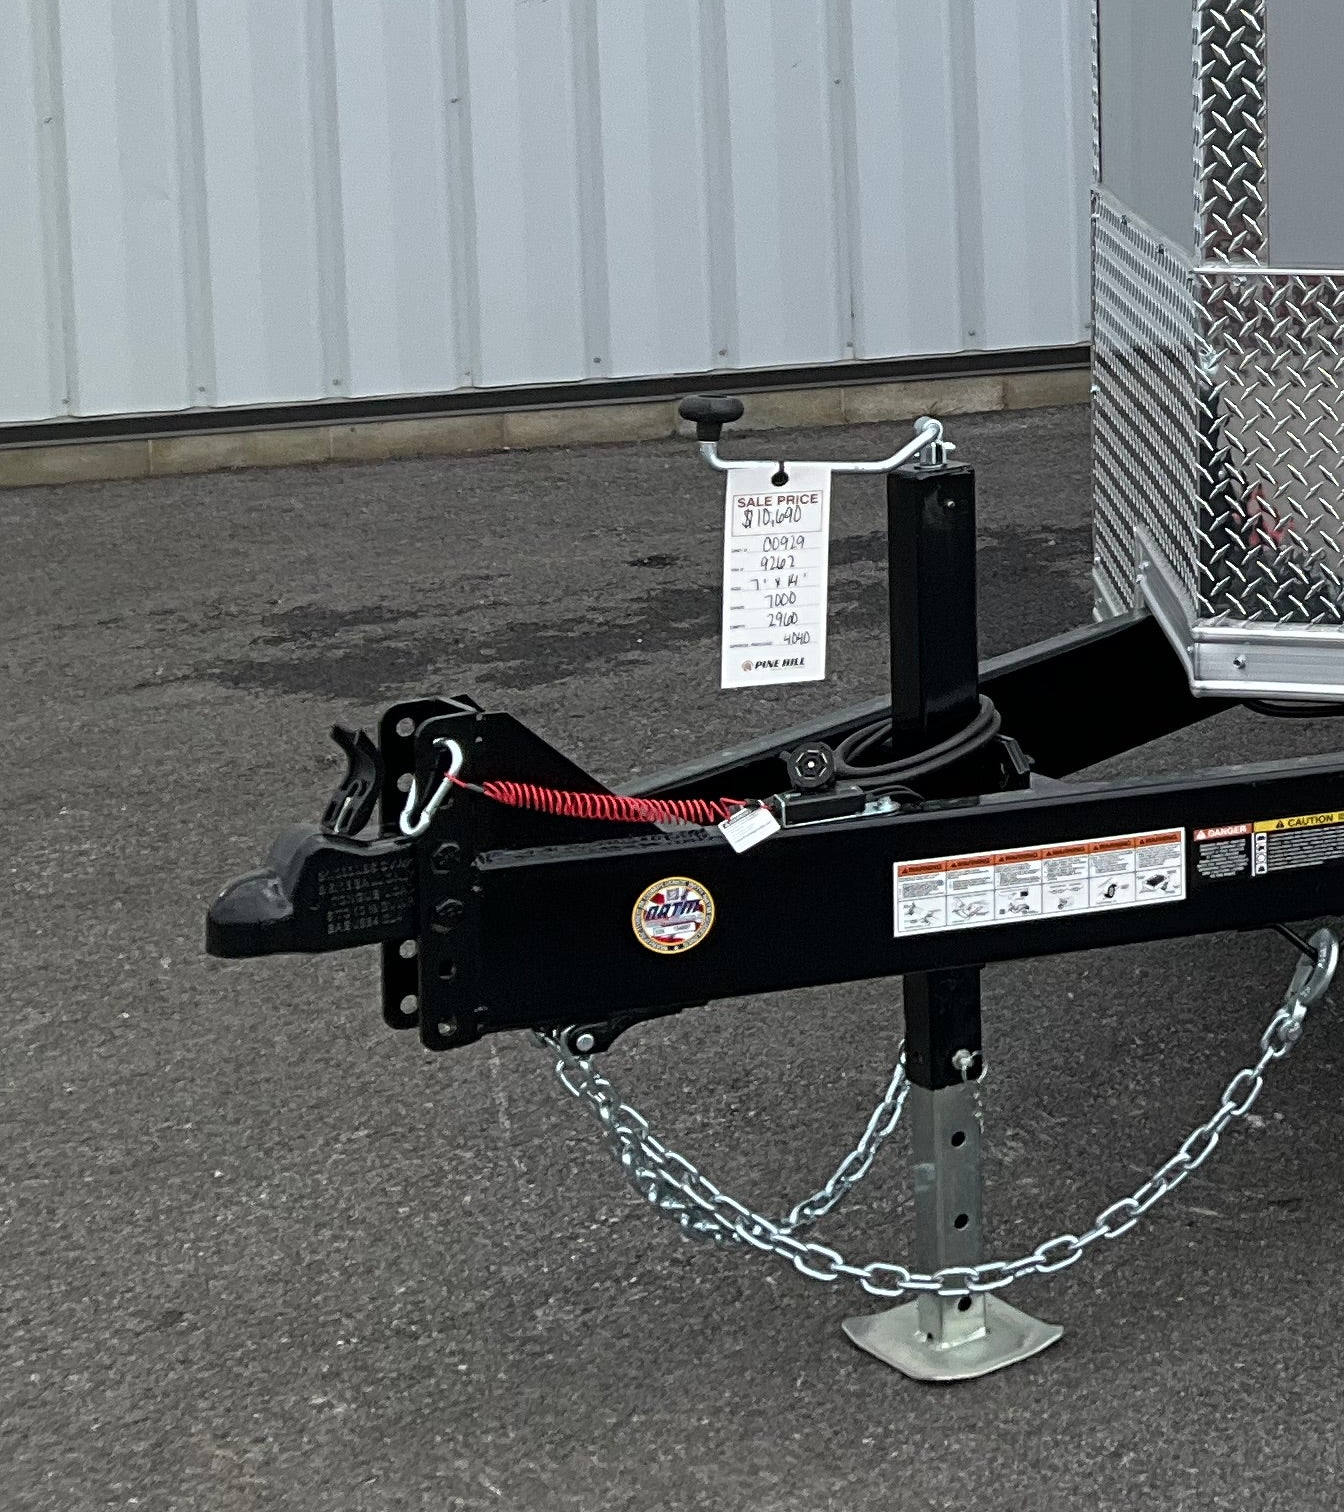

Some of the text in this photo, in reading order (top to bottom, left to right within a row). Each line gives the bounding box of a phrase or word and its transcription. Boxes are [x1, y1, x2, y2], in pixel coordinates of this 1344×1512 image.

[737, 494, 819, 508] SALE PRICE
[1287, 813, 1334, 828] CAUTION
